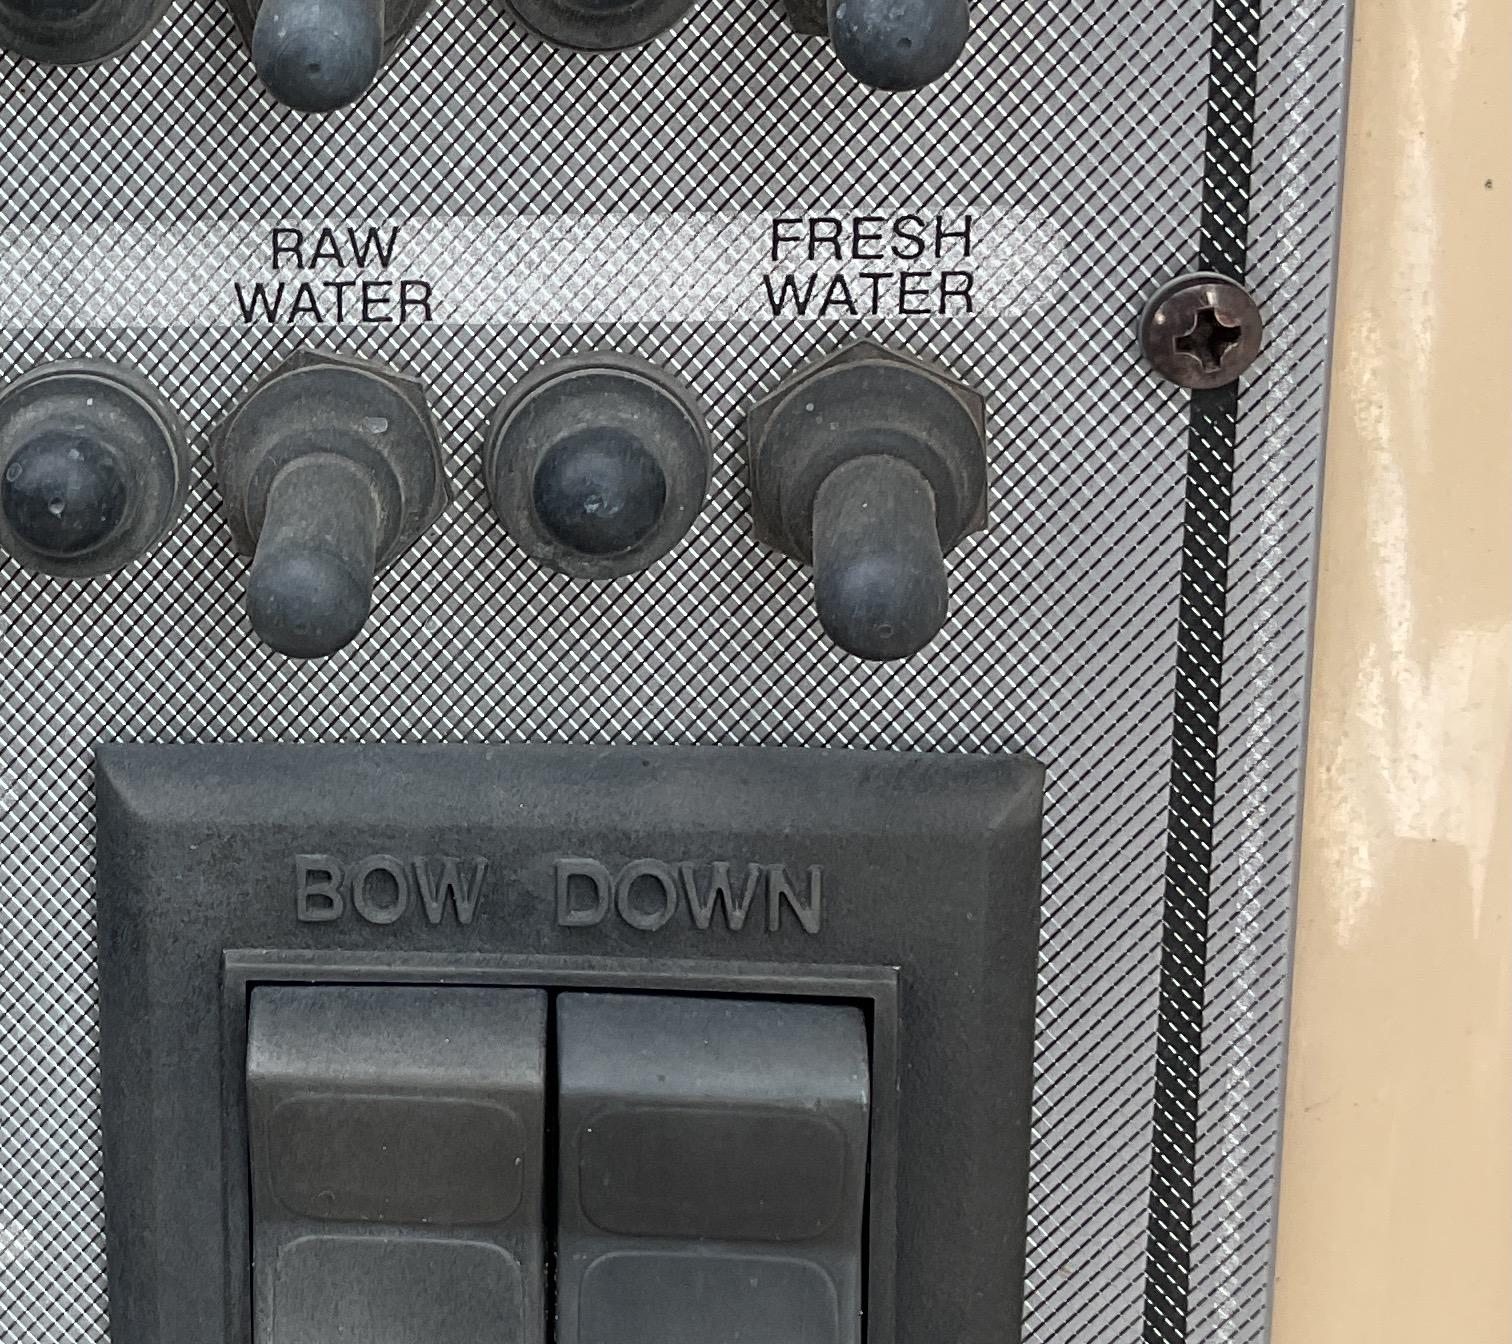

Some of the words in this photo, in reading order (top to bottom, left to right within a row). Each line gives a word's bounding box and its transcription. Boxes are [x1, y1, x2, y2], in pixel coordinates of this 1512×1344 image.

[272, 225, 403, 272] RAW
[771, 215, 973, 261] FRESH
[234, 278, 434, 326] WATER
[762, 270, 975, 319] WATER
[295, 854, 488, 924] BOW
[555, 858, 824, 934] DOWN
